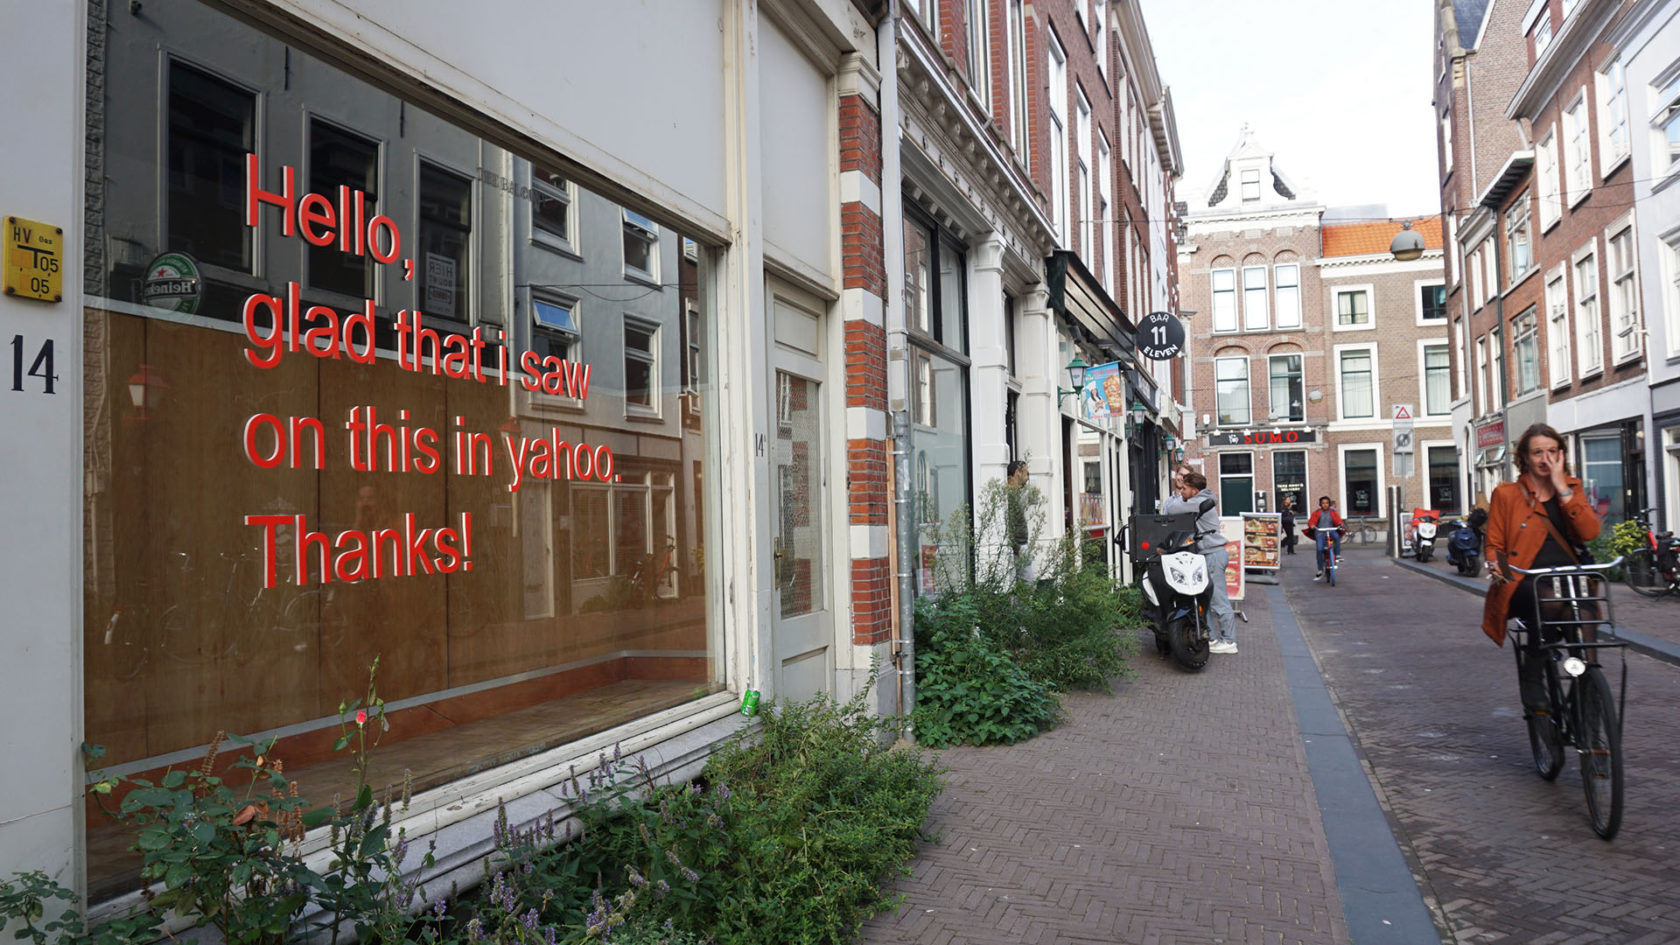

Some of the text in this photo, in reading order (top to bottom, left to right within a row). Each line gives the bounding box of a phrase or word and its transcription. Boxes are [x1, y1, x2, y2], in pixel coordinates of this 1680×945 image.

[13, 226, 32, 244] HV
[246, 153, 414, 281] Hello,
[1149, 313, 1170, 323] BAR
[1151, 326, 1167, 345] 11
[243, 281, 592, 400] glad that i saw
[1143, 344, 1179, 358] ELEVEN
[10, 334, 59, 395] 14
[244, 406, 622, 492] on this in yahoo.
[1243, 431, 1299, 444] SUMO
[244, 512, 472, 588] Thanks!
